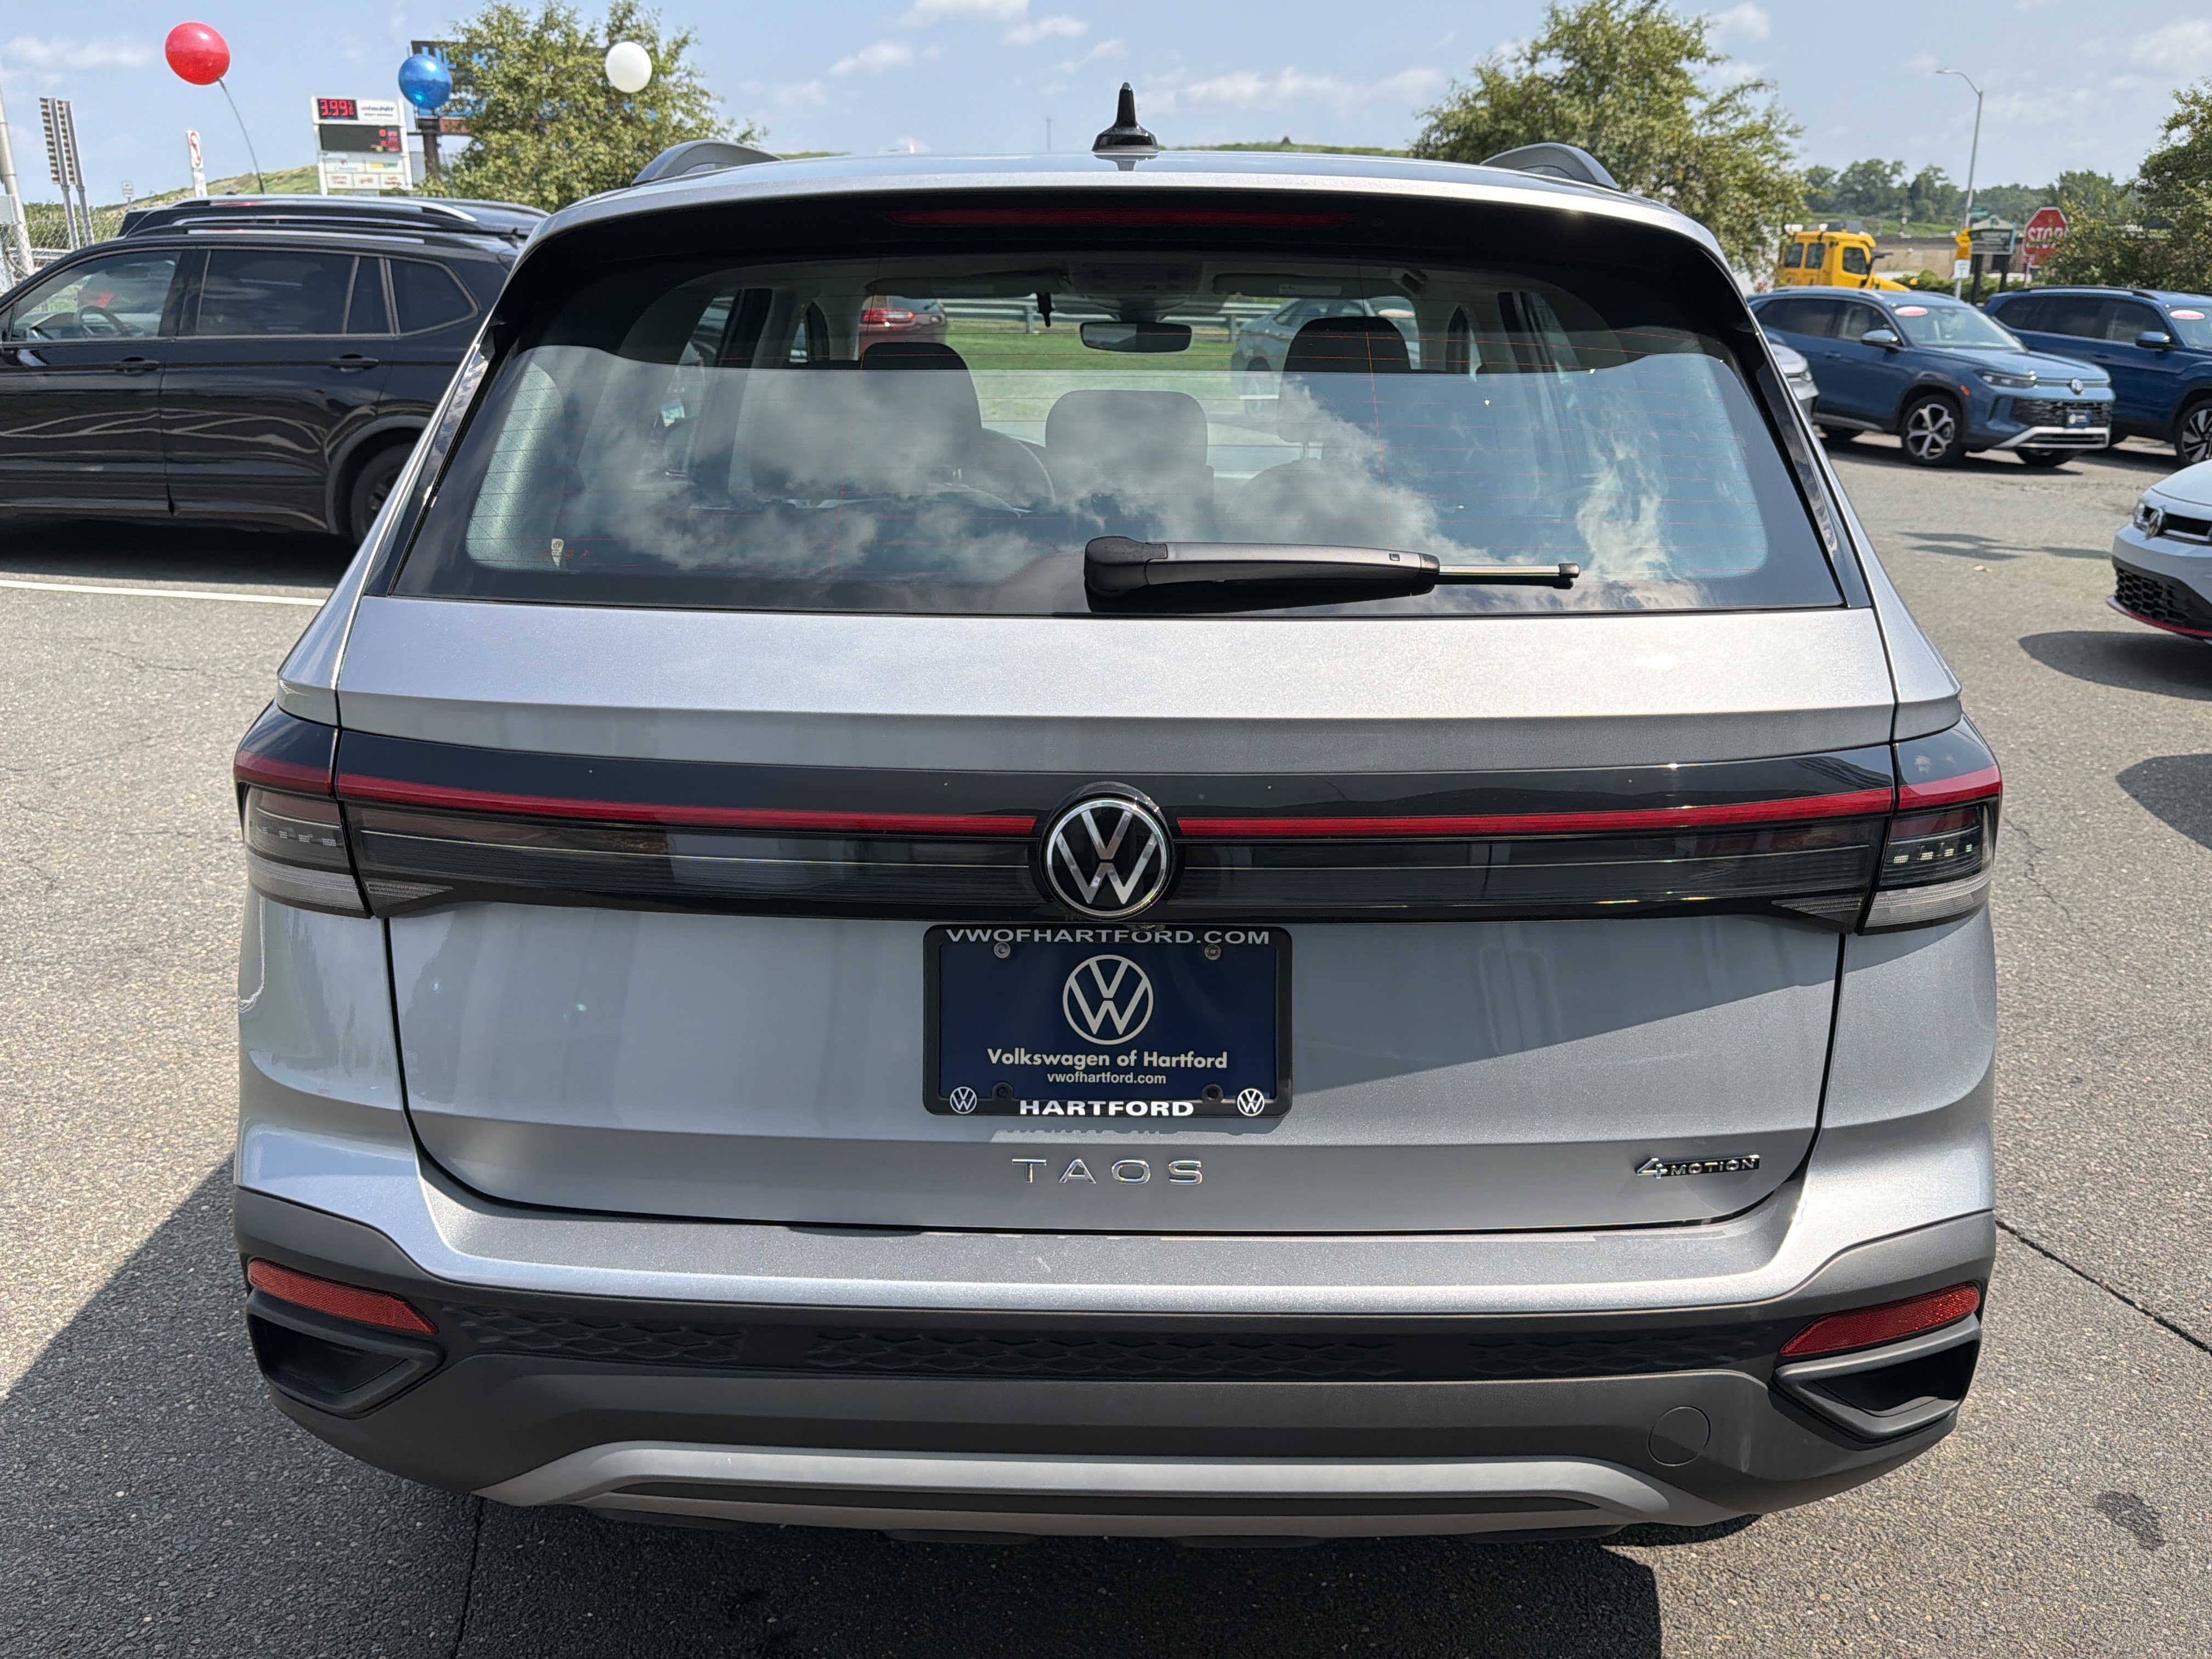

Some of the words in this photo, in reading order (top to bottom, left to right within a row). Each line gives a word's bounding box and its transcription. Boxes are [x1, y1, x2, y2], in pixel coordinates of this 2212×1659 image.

[946, 928, 1269, 944] VWOFHARTFORD.COM
[987, 1048, 1110, 1070] Volkswagen
[1116, 1049, 1137, 1066] of
[1143, 1051, 1227, 1069] Hartford
[1047, 1071, 1166, 1085] vwofhartford.com
[1019, 1100, 1194, 1116] HARTFORD
[1012, 1158, 1203, 1185] TAOS
[1637, 1157, 1755, 1179] 4MOTION
